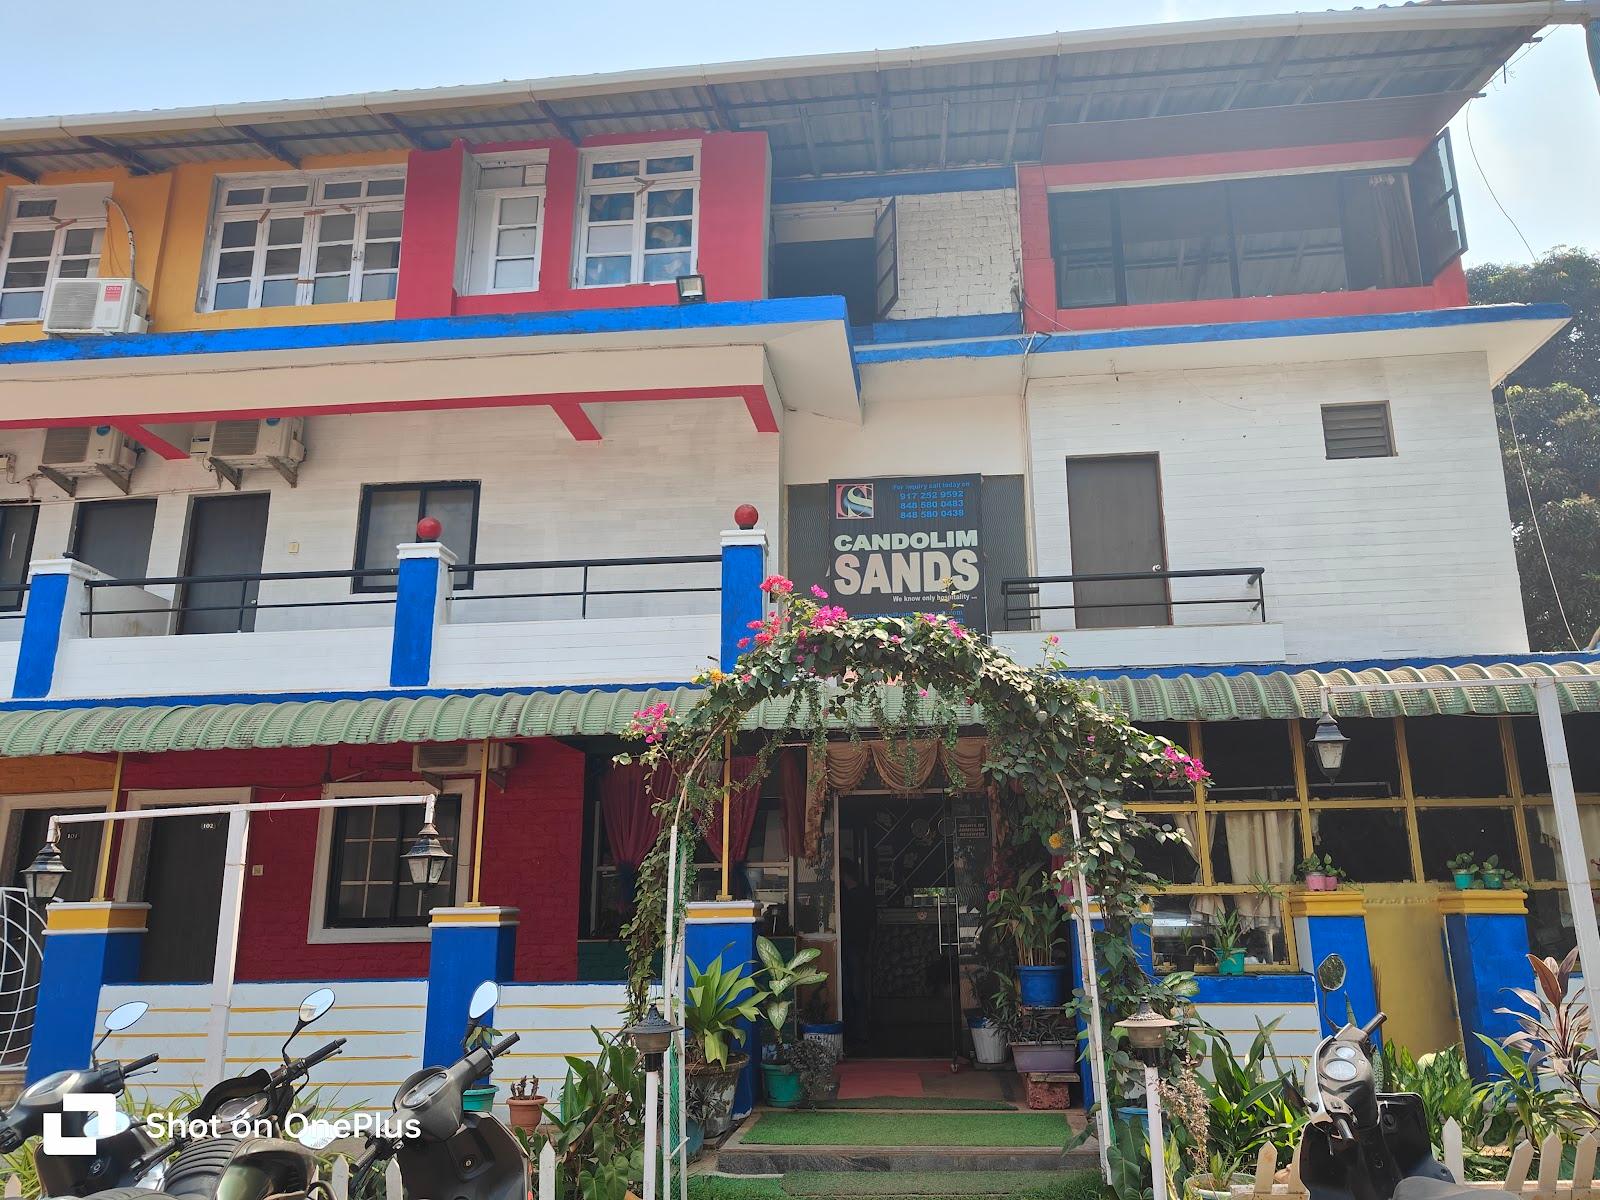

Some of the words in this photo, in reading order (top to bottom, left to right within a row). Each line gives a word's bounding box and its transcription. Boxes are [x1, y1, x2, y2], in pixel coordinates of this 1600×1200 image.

[942, 481, 961, 489] today
[940, 490, 964, 498] 9592
[900, 511, 918, 519] 848
[920, 510, 938, 518] 580
[834, 529, 978, 551] CANDOLIM
[834, 549, 979, 595] SANDS
[922, 594, 936, 602] only
